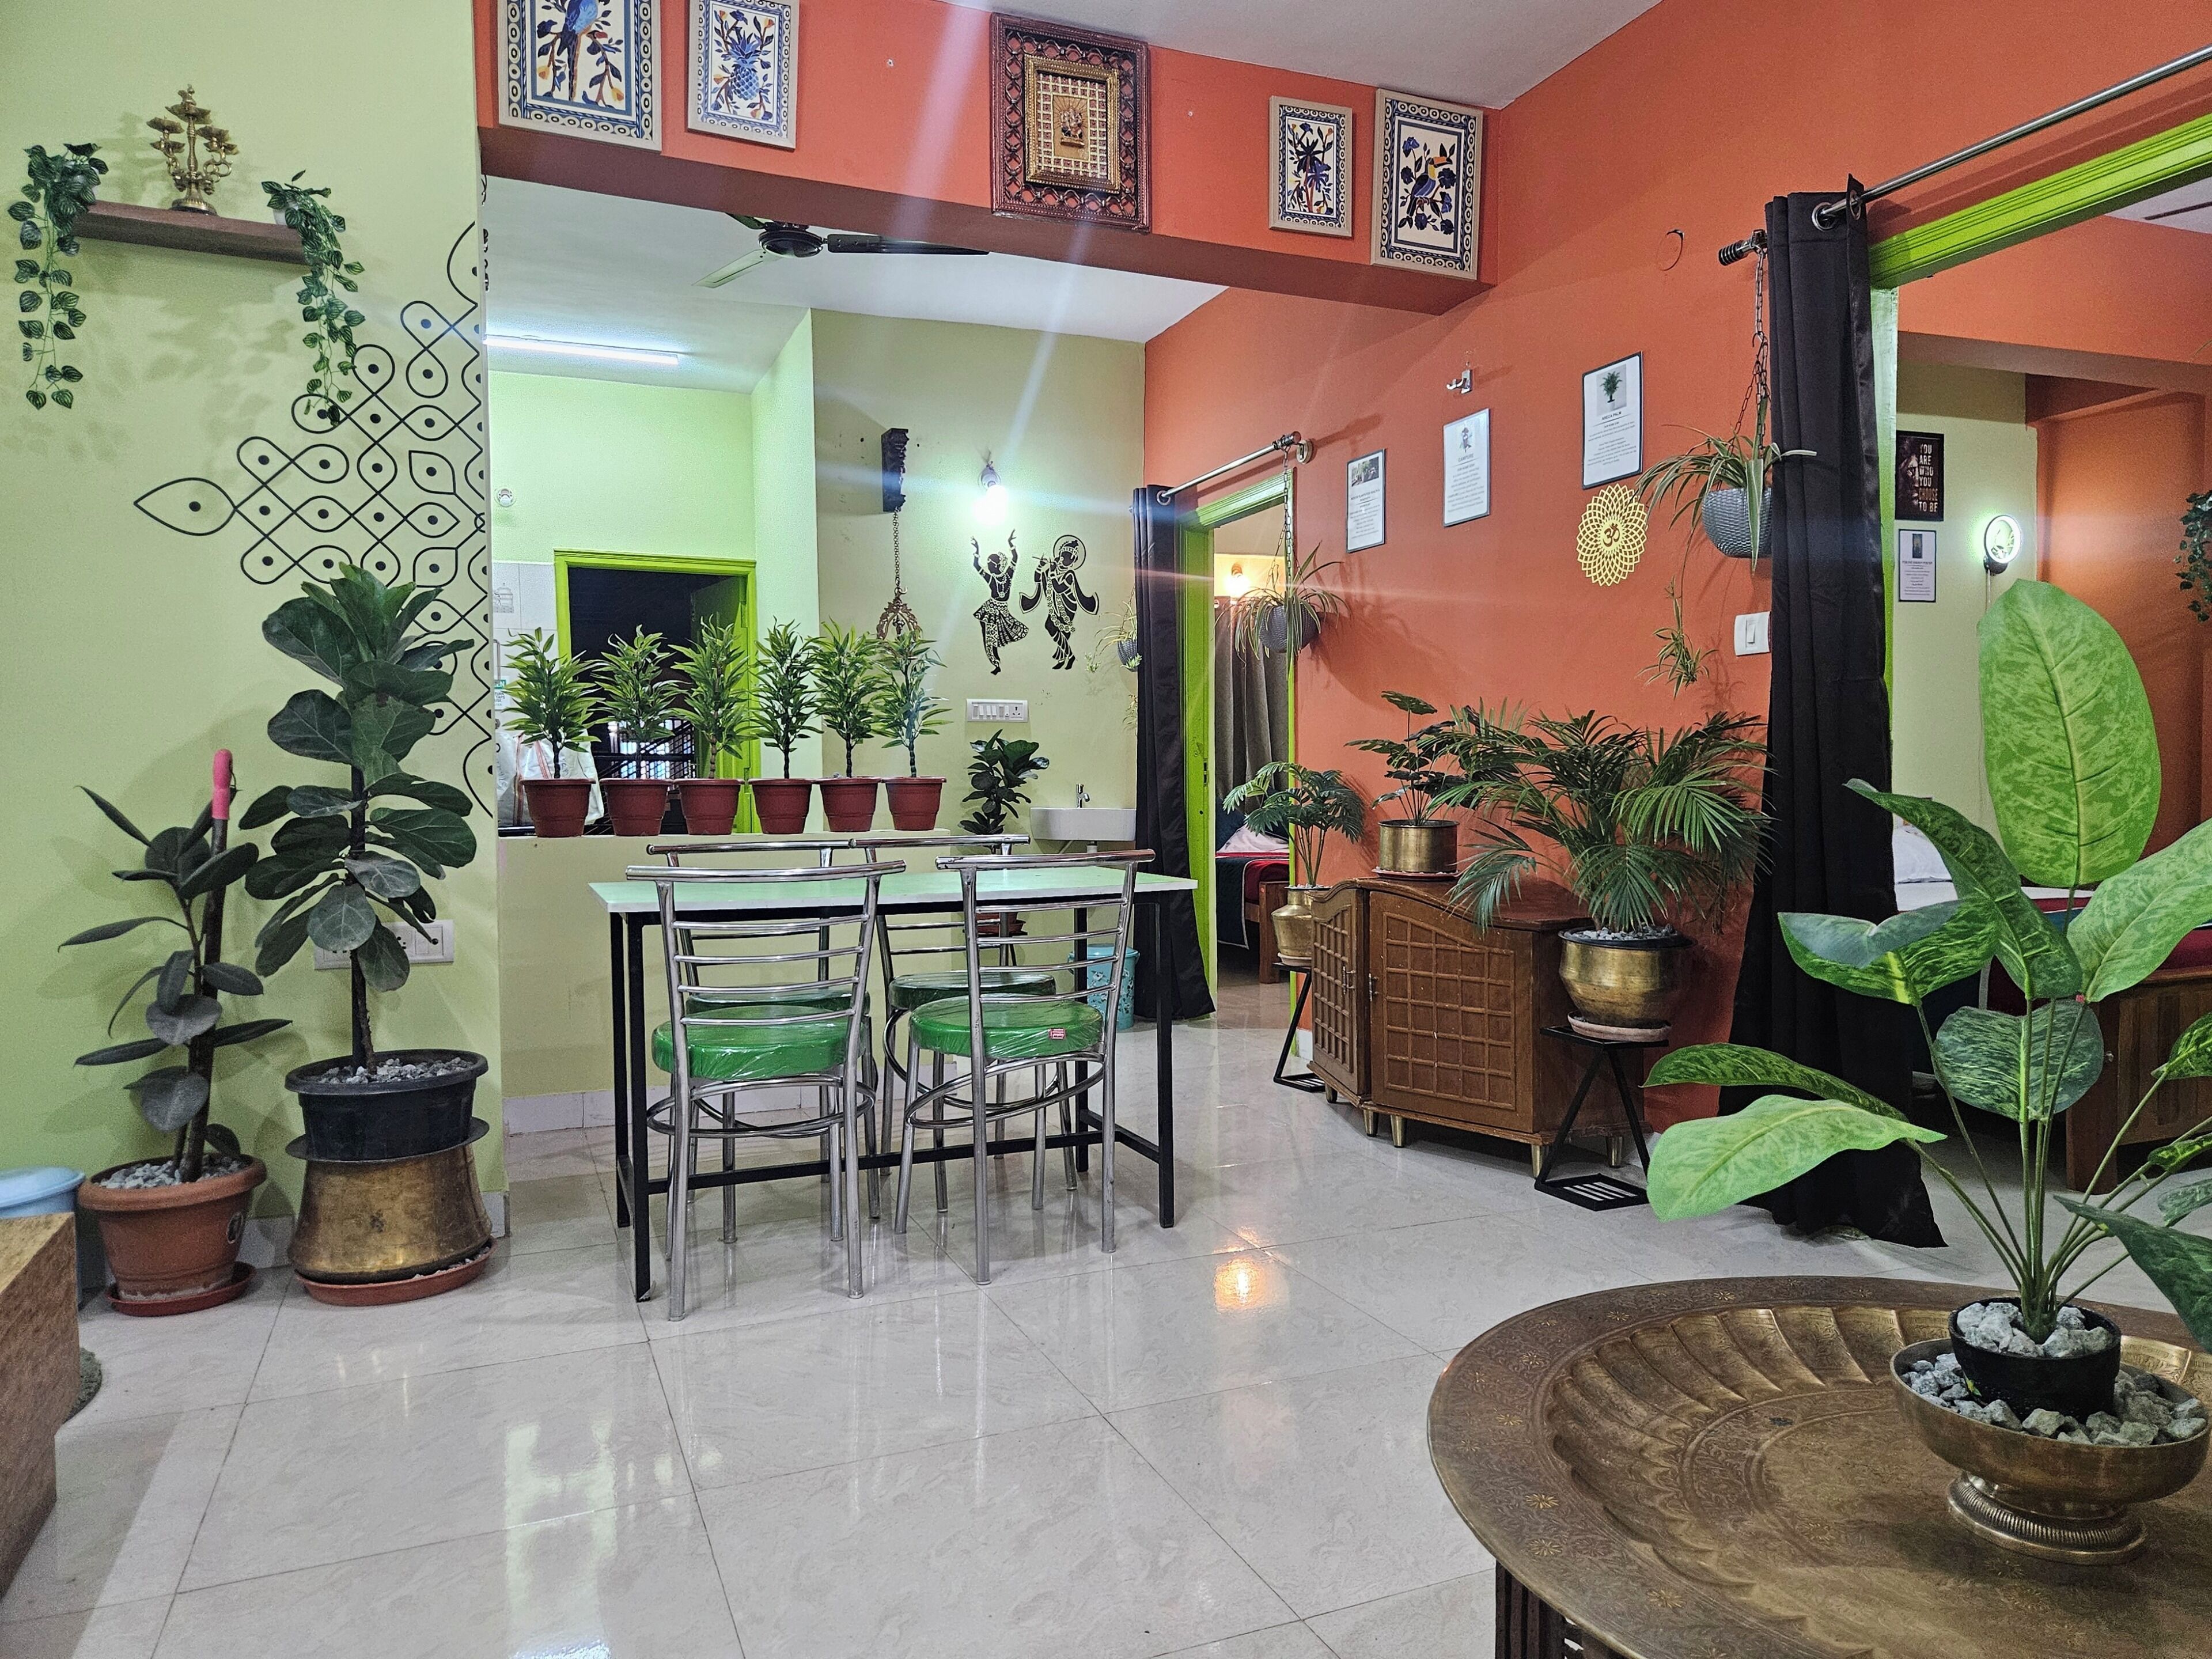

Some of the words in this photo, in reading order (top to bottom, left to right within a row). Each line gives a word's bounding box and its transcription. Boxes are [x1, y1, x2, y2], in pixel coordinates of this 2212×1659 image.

[1919, 444, 1932, 454] YOU
[1919, 454, 1932, 465] ARE
[1919, 465, 1934, 476] WHO
[1919, 476, 1931, 487] YOU
[1919, 487, 1938, 501] CHOOSE
[1919, 501, 1927, 512] TO
